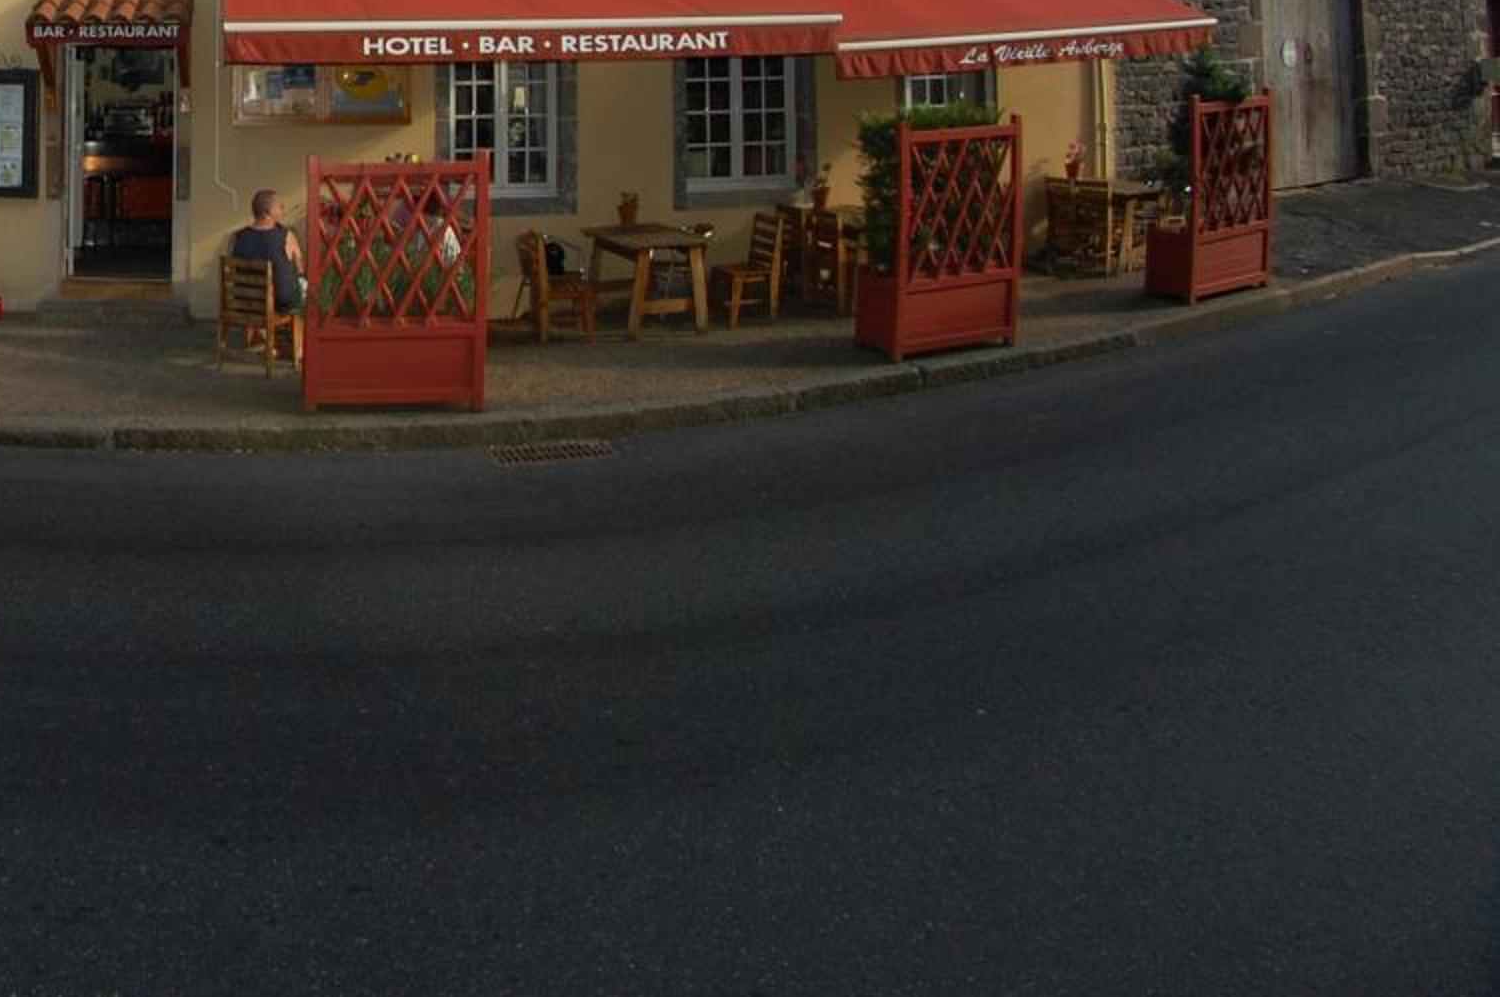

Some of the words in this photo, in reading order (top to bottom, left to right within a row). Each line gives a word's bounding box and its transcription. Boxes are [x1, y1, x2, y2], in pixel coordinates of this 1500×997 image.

[33, 25, 65, 38] BAR
[79, 25, 180, 38] RESTAURANT
[363, 36, 453, 56] HOTEL
[479, 35, 535, 54] BAR
[561, 31, 729, 52] RESTAURANT
[959, 47, 989, 64] La
[1059, 39, 1124, 56] Auberge
